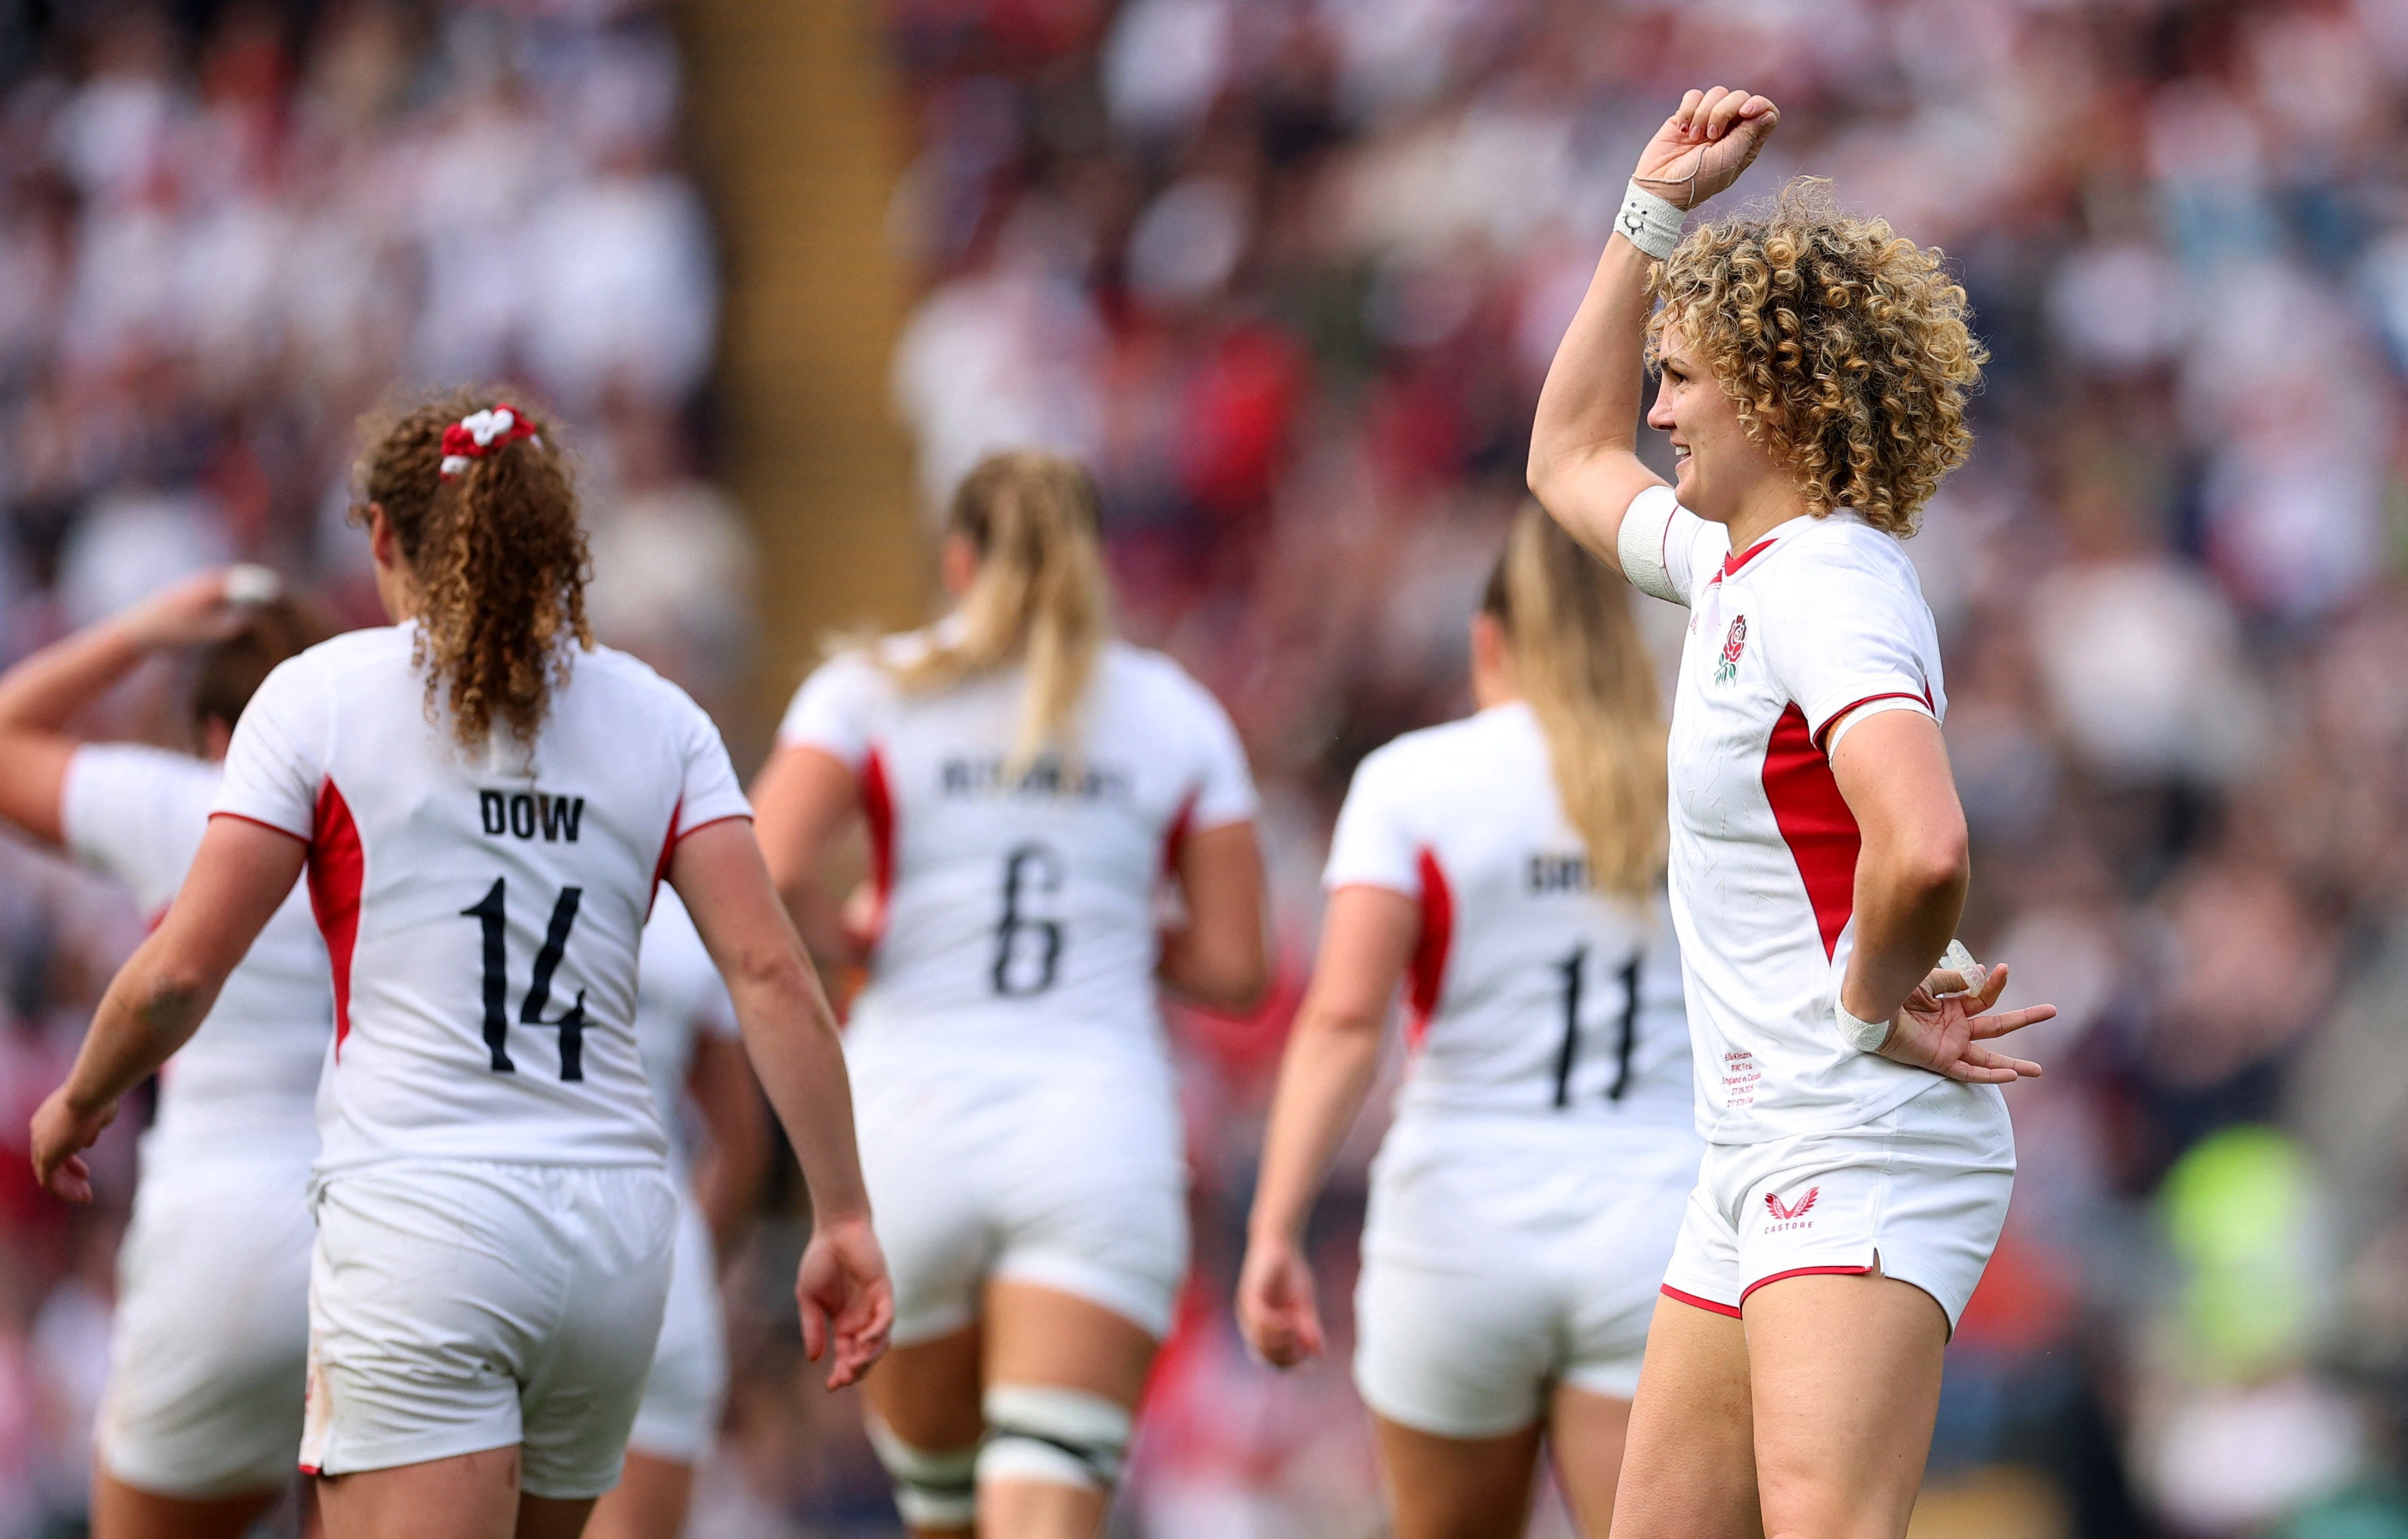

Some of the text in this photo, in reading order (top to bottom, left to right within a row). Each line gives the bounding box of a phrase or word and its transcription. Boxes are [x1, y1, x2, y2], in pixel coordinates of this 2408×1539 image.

[480, 789, 585, 843] DOW
[992, 841, 1067, 998] 6
[460, 876, 598, 1082] 14
[1549, 942, 1645, 1107] 11
[1722, 1075, 1741, 1086] England
[1764, 1221, 1813, 1234] CASTORE
